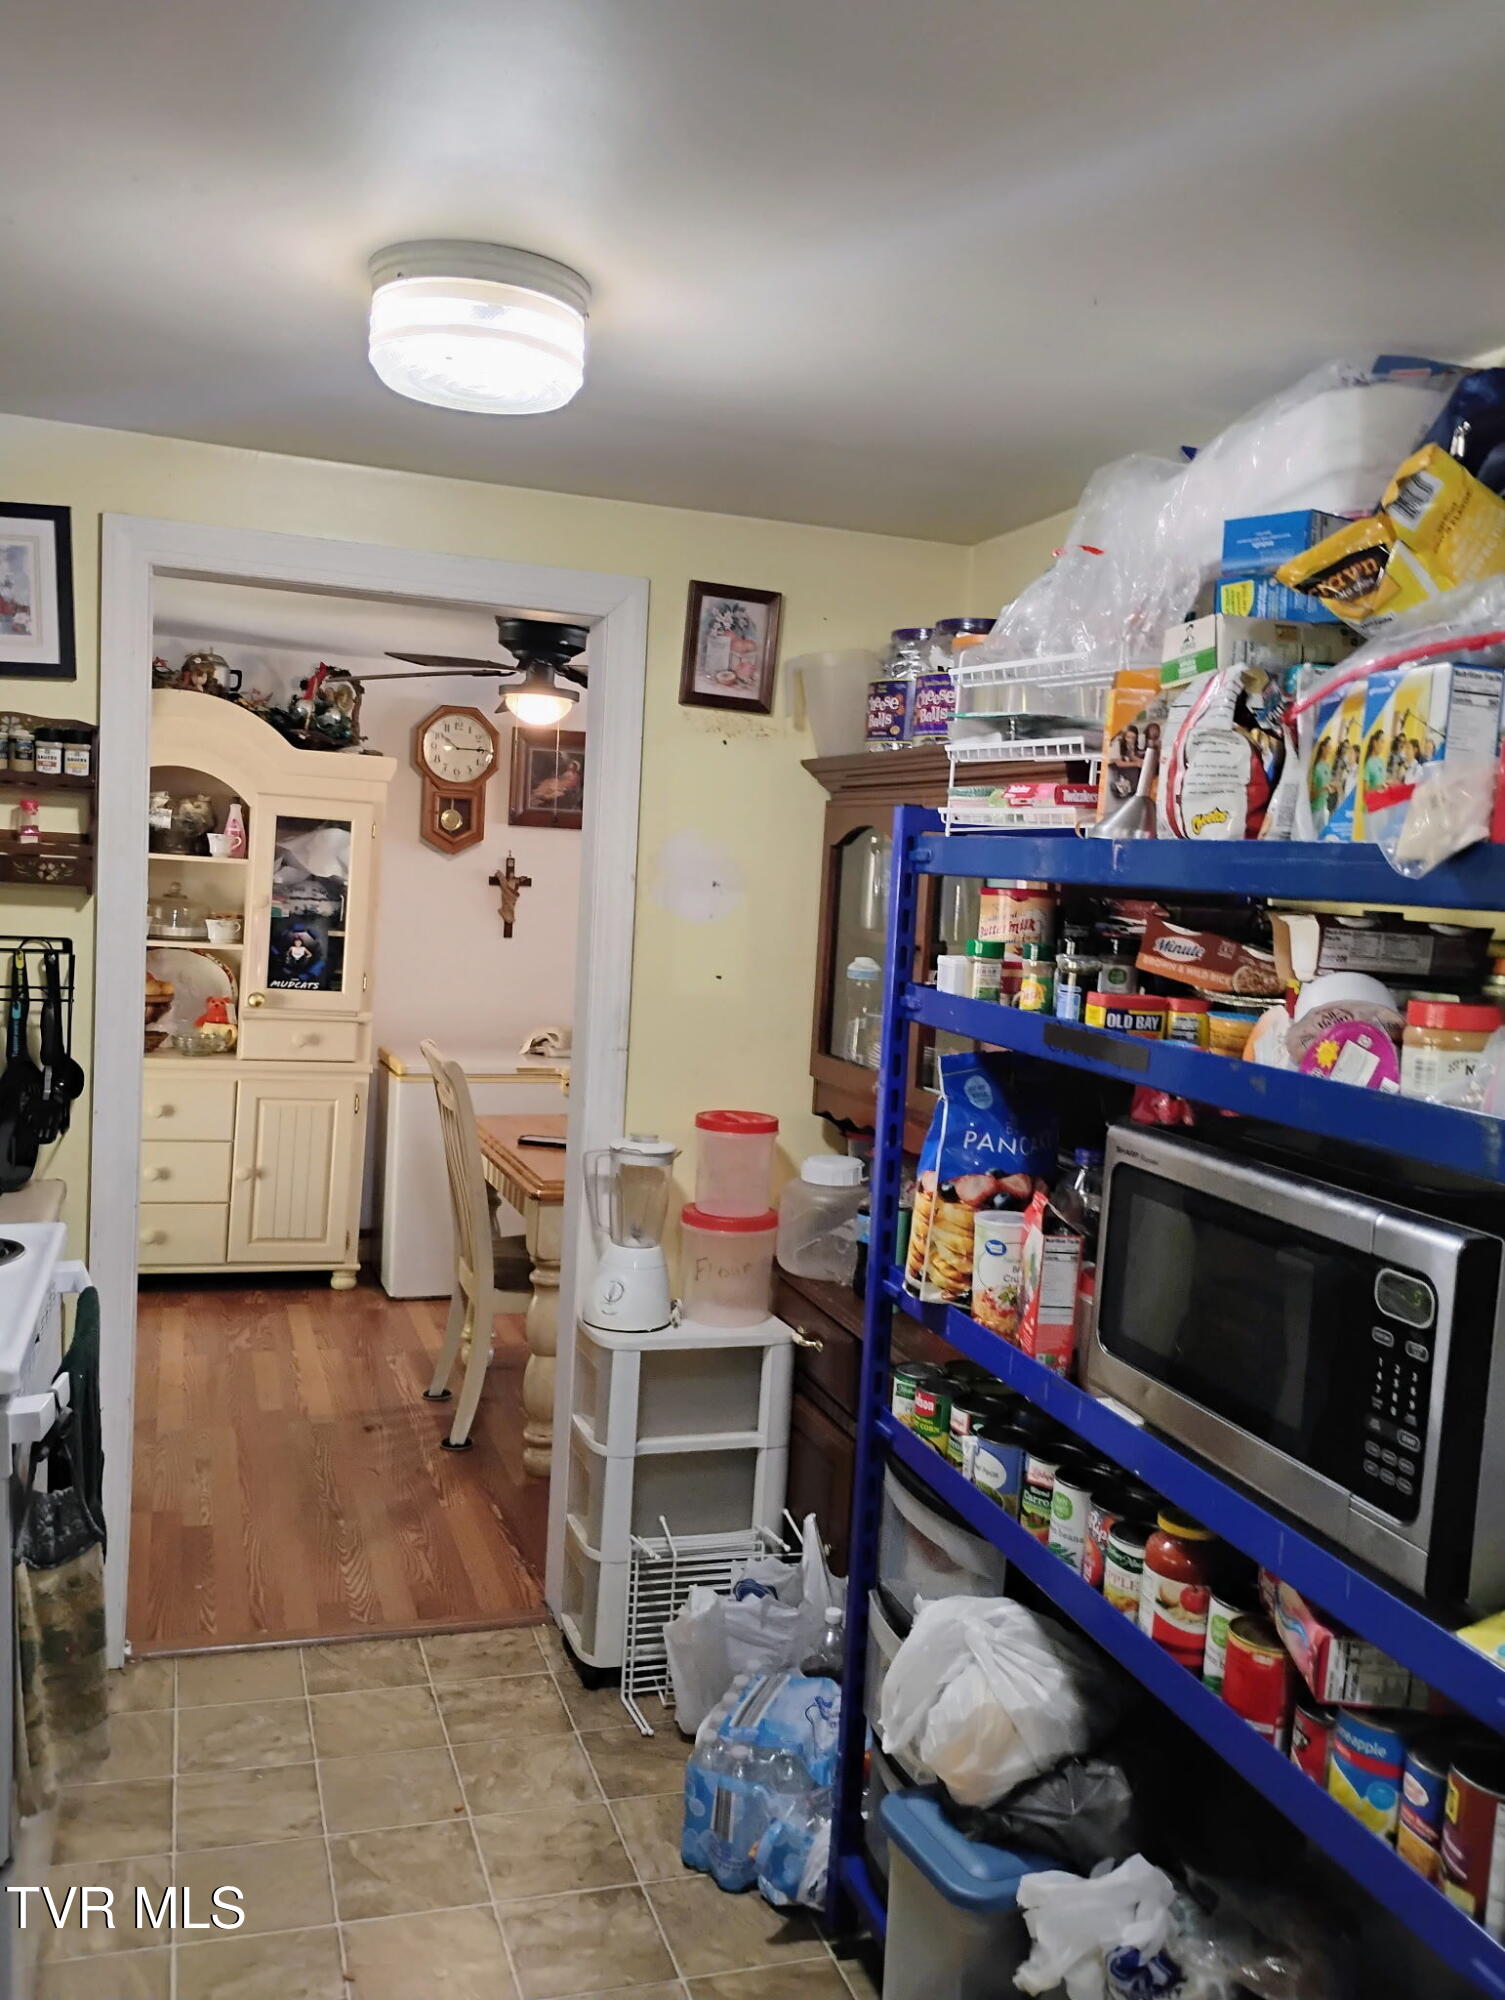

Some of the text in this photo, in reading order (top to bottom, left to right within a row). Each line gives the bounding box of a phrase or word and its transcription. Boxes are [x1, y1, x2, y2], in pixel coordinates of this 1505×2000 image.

[868, 696, 900, 712] heese
[1158, 938, 1204, 958] Minute
[270, 979, 320, 990] MUDCATS
[1106, 1013, 1133, 1029] OLD
[1136, 1014, 1160, 1031] BAY
[1337, 1724, 1387, 1759] neapple
